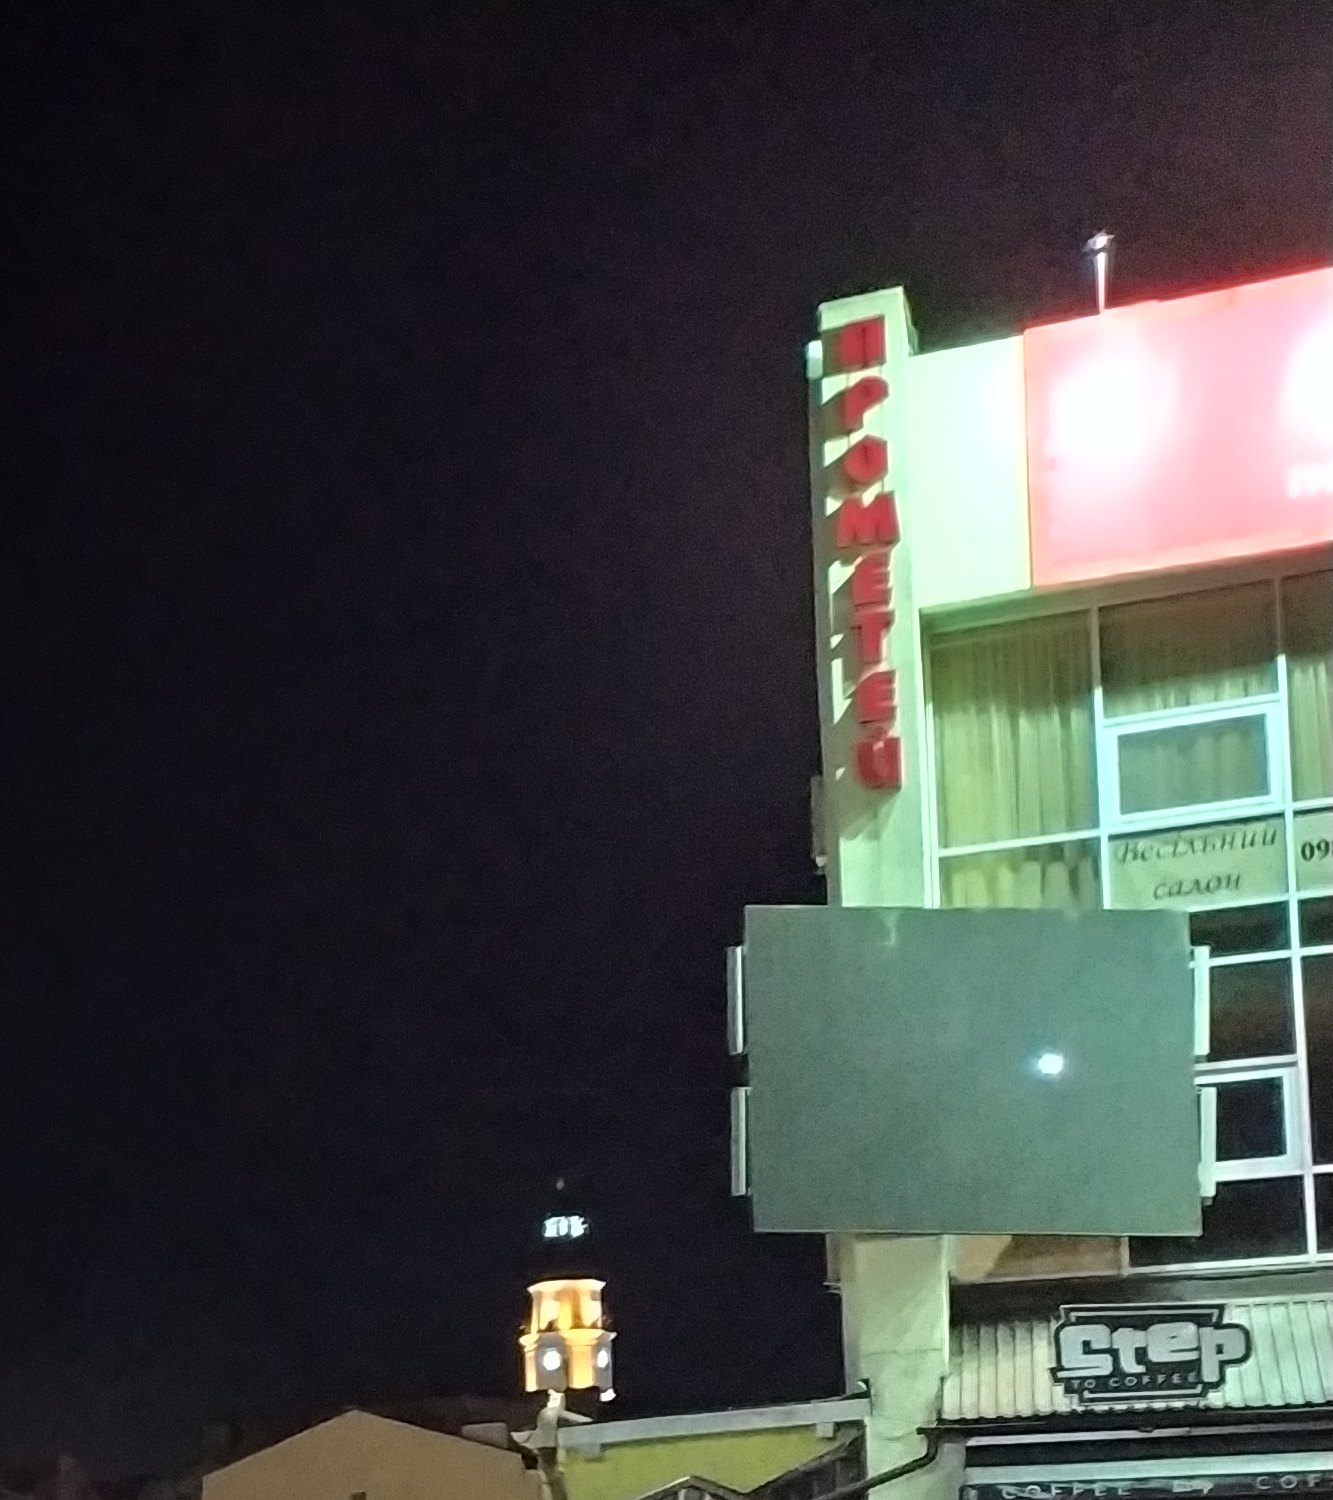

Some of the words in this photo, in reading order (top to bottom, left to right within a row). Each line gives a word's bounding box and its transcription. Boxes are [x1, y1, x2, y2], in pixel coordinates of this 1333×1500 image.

[1300, 838, 1333, 862] 09
[1057, 1321, 1247, 1383] Step
[1109, 1371, 1200, 1388] COFFEE
[1255, 1473, 1333, 1490] COF
